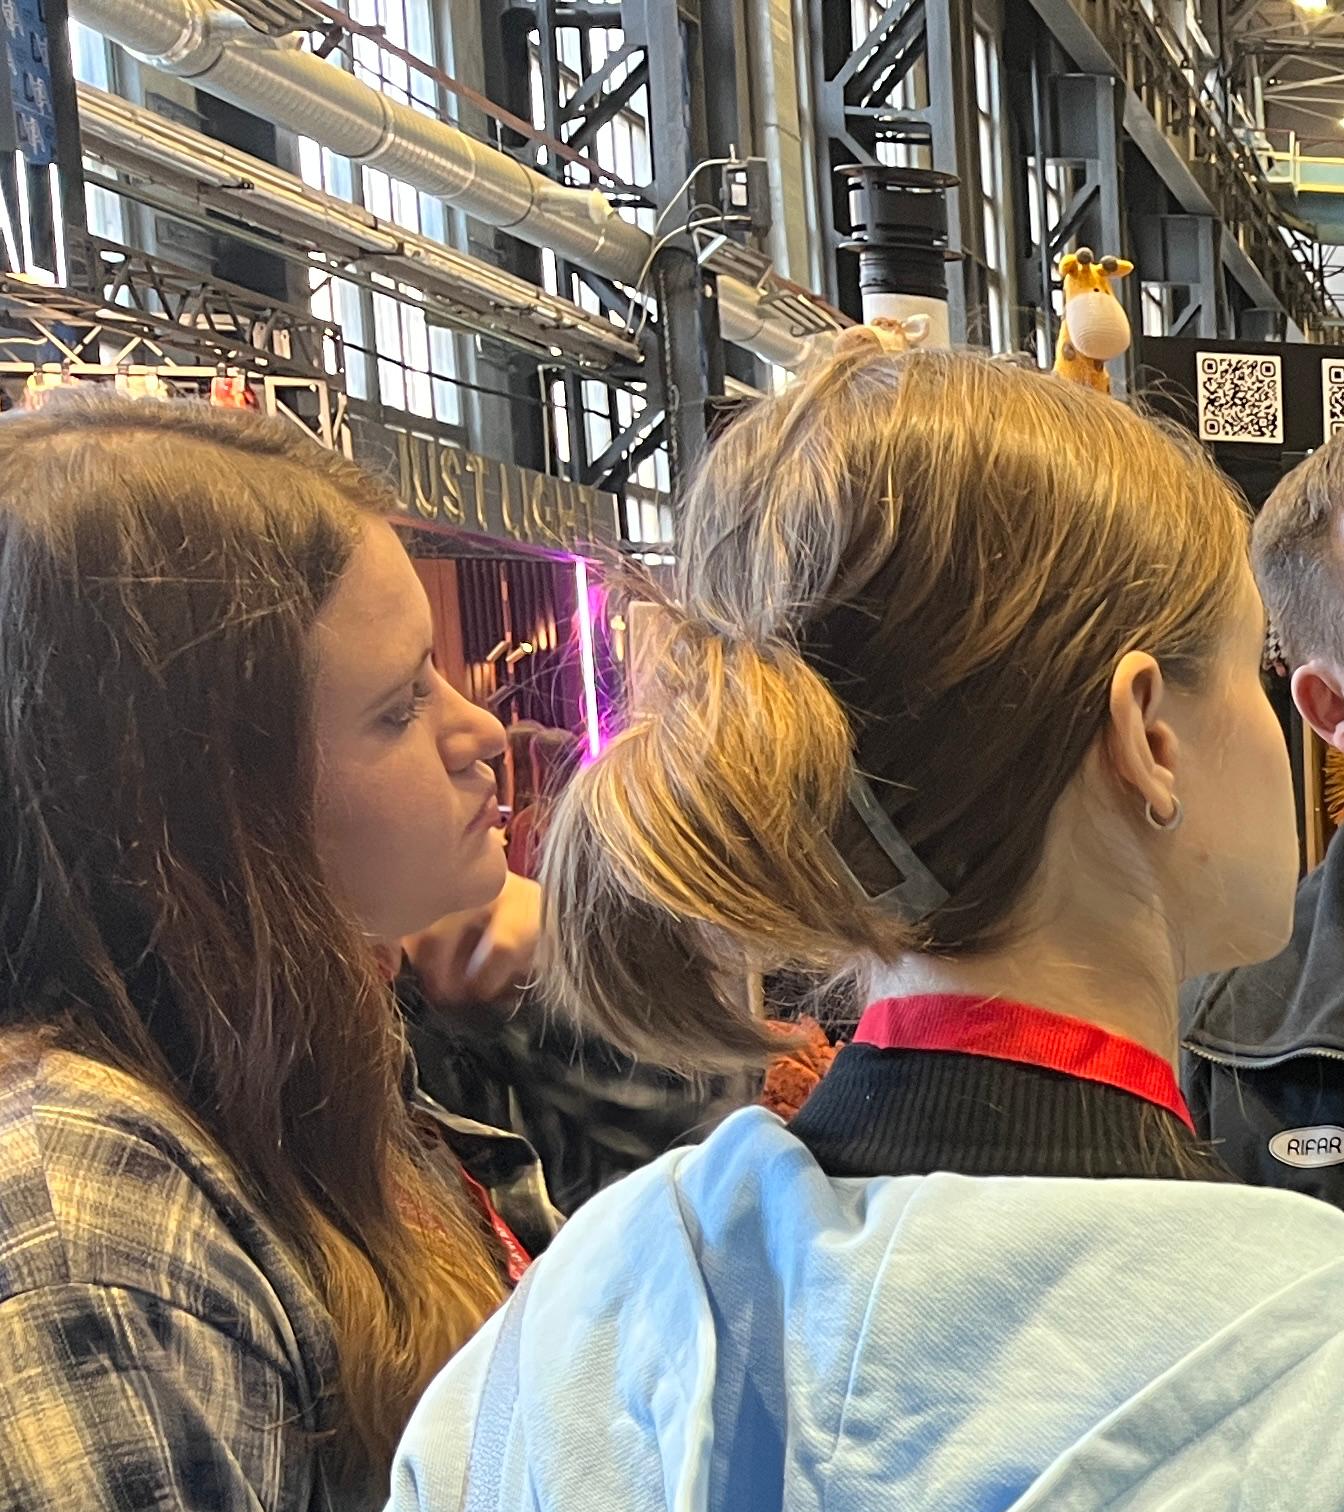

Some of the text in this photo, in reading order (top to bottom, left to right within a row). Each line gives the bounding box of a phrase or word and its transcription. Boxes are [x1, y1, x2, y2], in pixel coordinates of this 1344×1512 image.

[396, 433, 600, 547] JUST LIGHT
[1286, 1136, 1342, 1156] RIFAR
